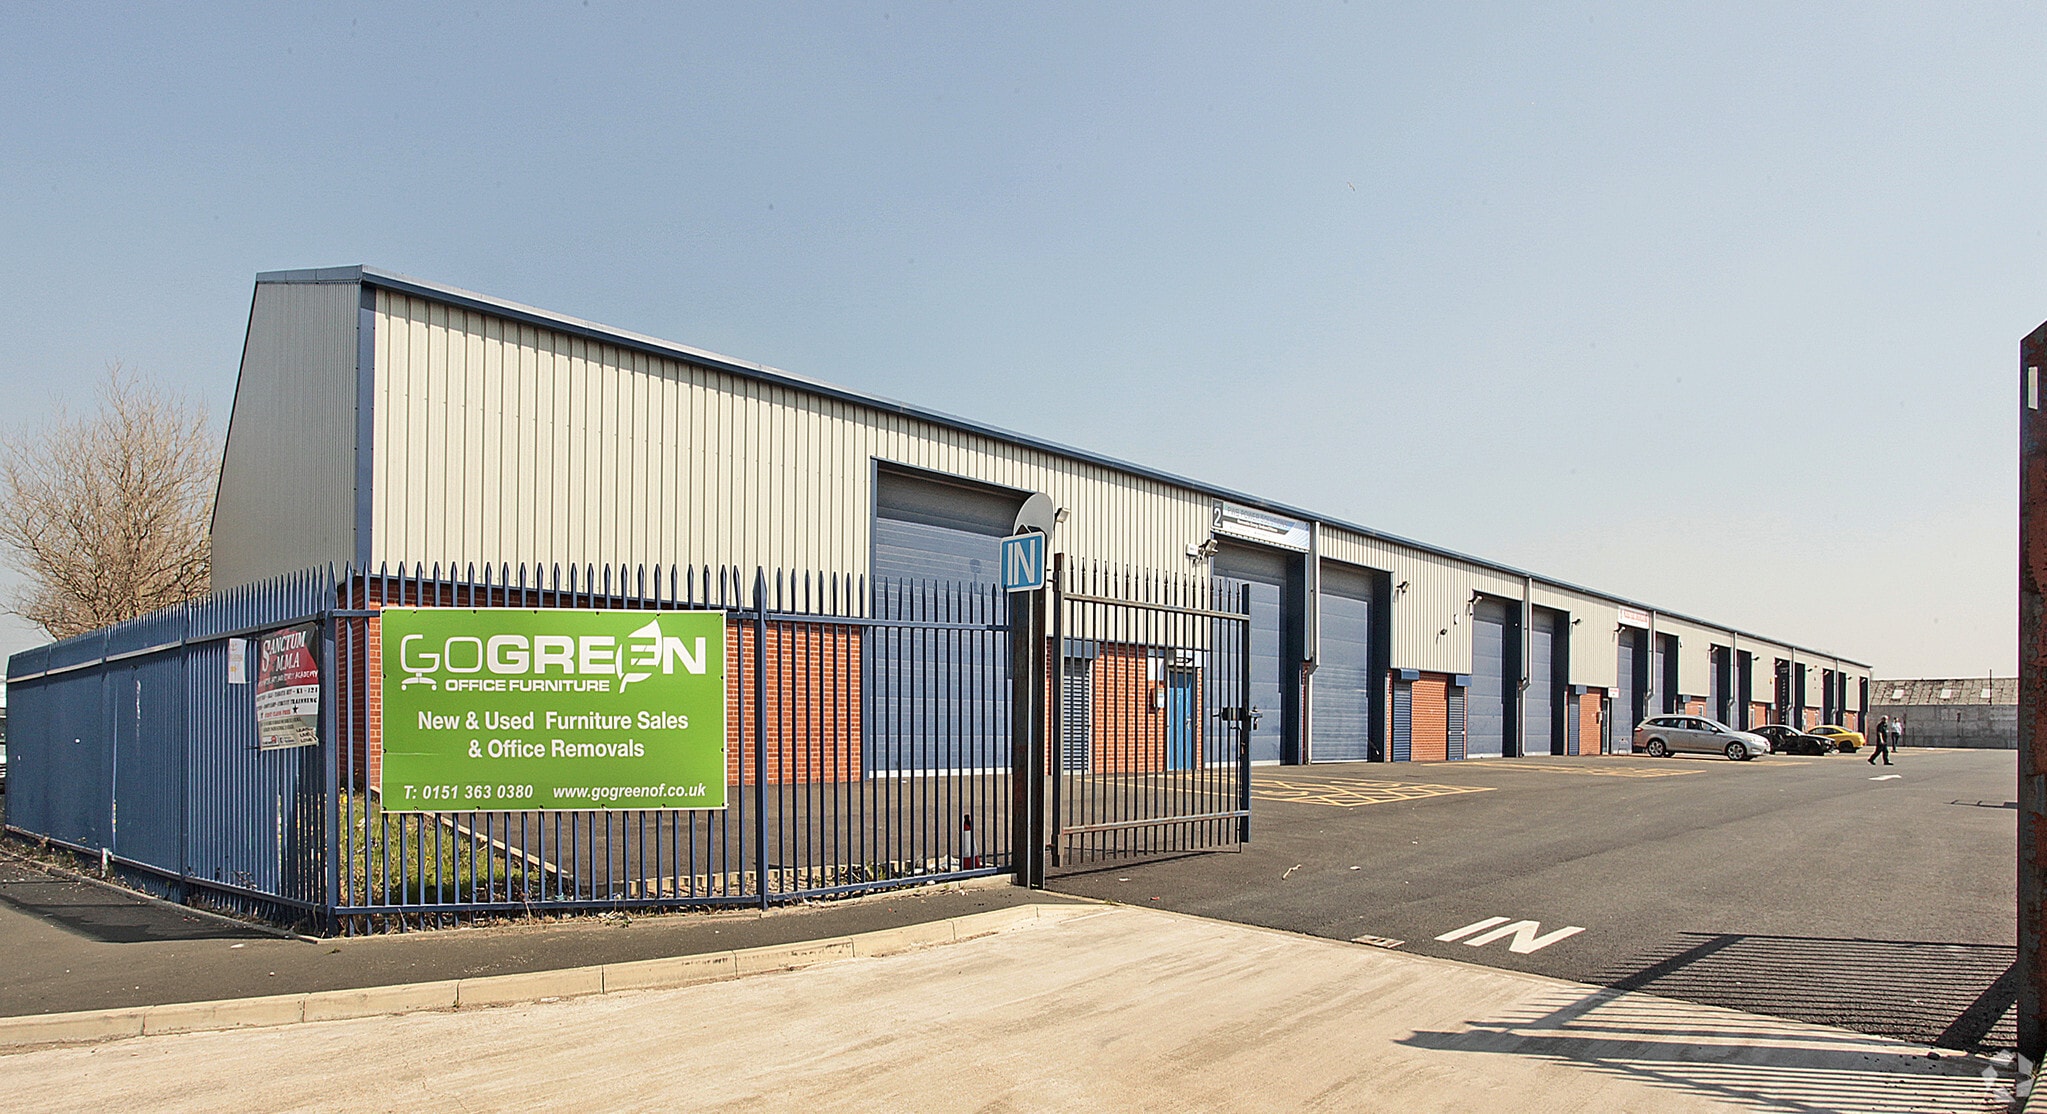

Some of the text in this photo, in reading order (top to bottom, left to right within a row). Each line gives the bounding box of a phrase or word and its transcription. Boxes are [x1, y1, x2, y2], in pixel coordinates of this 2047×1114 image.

[1213, 507, 1222, 528] 2
[1007, 539, 1036, 586] IN
[261, 630, 307, 673] SANCTUM
[445, 679, 610, 692] OFFICE FURNITURE
[418, 710, 689, 730] New & Used Furniture Sales
[468, 738, 645, 758] & Office Removals
[403, 782, 707, 801] T: 0151 363 0380 www.gogreenof.co.uk
[1434, 916, 1586, 955] IN
